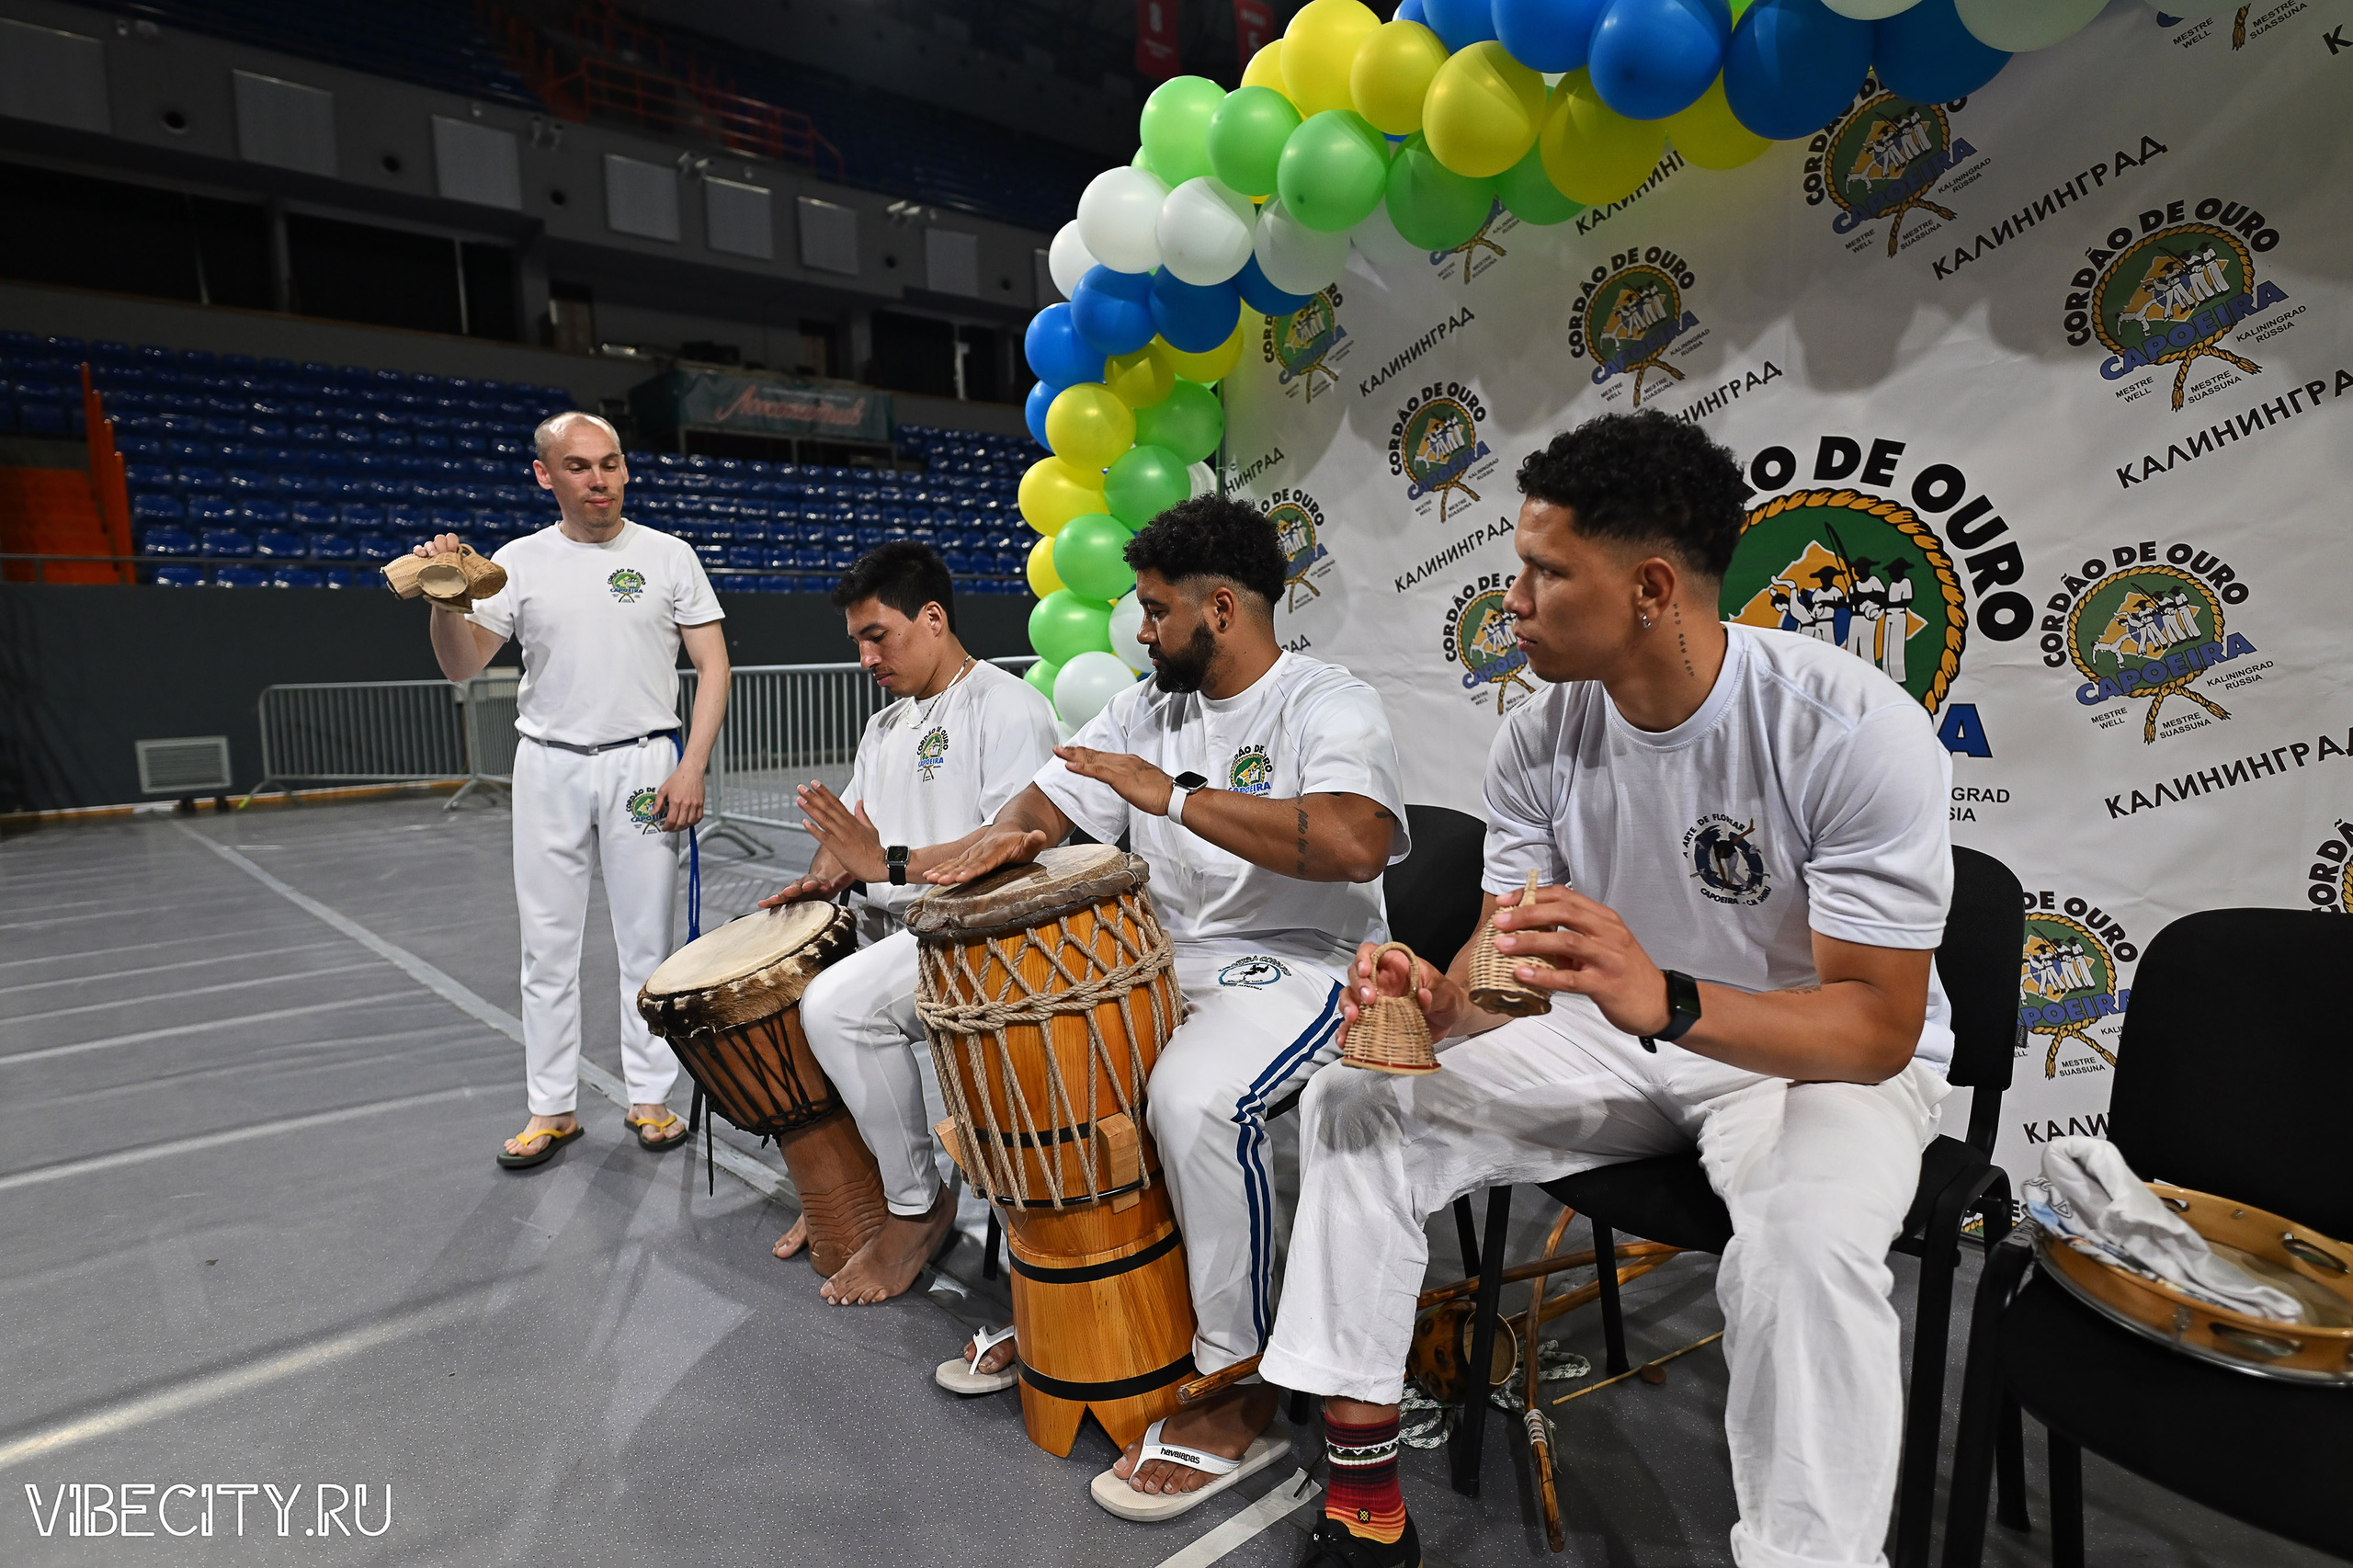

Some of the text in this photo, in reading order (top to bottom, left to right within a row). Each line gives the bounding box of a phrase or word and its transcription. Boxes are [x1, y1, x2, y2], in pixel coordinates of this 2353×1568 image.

[2173, 17, 2213, 45] MESTRE
[2249, 3, 2308, 40] SUASSUNA
[2182, 31, 2211, 49] WELL
[1833, 138, 1977, 234] CAPOEIRA
[1938, 157, 1991, 193] KALININGRAD
[1932, 135, 2168, 280] КАЛИНИНГРАД
[1845, 228, 1875, 250] MESTRE
[1852, 240, 1873, 253] WELL
[1903, 218, 1934, 240] MESTRE
[2063, 198, 2279, 347] CORDÃO DE OURO
[1568, 246, 1695, 358] CORDÃO DE OURO
[2099, 279, 2289, 381] CAPOEIRA
[2235, 304, 2307, 343] KALININGRAD
[1359, 307, 1474, 397] КАЛИНИНГРАД
[1592, 310, 1699, 384] CAPOEIRA
[1675, 360, 1783, 426] НИНГРАД
[2115, 376, 2154, 399] MESTRE
[2124, 388, 2152, 403] WELL
[2188, 375, 2243, 404] SUASSUNA
[2190, 369, 2232, 393] MESTRE
[1389, 381, 1486, 475] CORDÃO DE OURO
[2116, 369, 2353, 489] КАЛИНИНГРА
[1407, 440, 1491, 500] CAPOEIRA
[1272, 488, 1289, 505] DE
[1292, 489, 1324, 526] OURO
[1394, 516, 1514, 593] КАЛИНИНГРАД
[1813, 436, 2034, 642] DE OURO
[1443, 573, 1500, 662] CORDÃO DE
[2040, 541, 2249, 668] CORDÃO DE OURO
[2075, 631, 2257, 706] CAPOEIRA
[2206, 660, 2274, 687] KALININGRAD
[2091, 708, 2128, 724] MESTRE
[2099, 718, 2125, 730] WELL
[2159, 718, 2211, 739] SUASSUNA
[2162, 711, 2201, 729] MESTRE
[940, 730, 949, 750] OURO
[1254, 744, 1265, 754] DE
[2105, 726, 2353, 819] КАЛИНИНГРА
[1683, 826, 1697, 848] ARTE
[1697, 815, 1710, 826] DE
[1700, 888, 1739, 904] CAPOEIRA
[2063, 897, 2138, 962] OURO
[2059, 1065, 2105, 1076] SUASSUNA
[2062, 1057, 2096, 1067] MESTRE
[1160, 1447, 1200, 1464] havaianas
